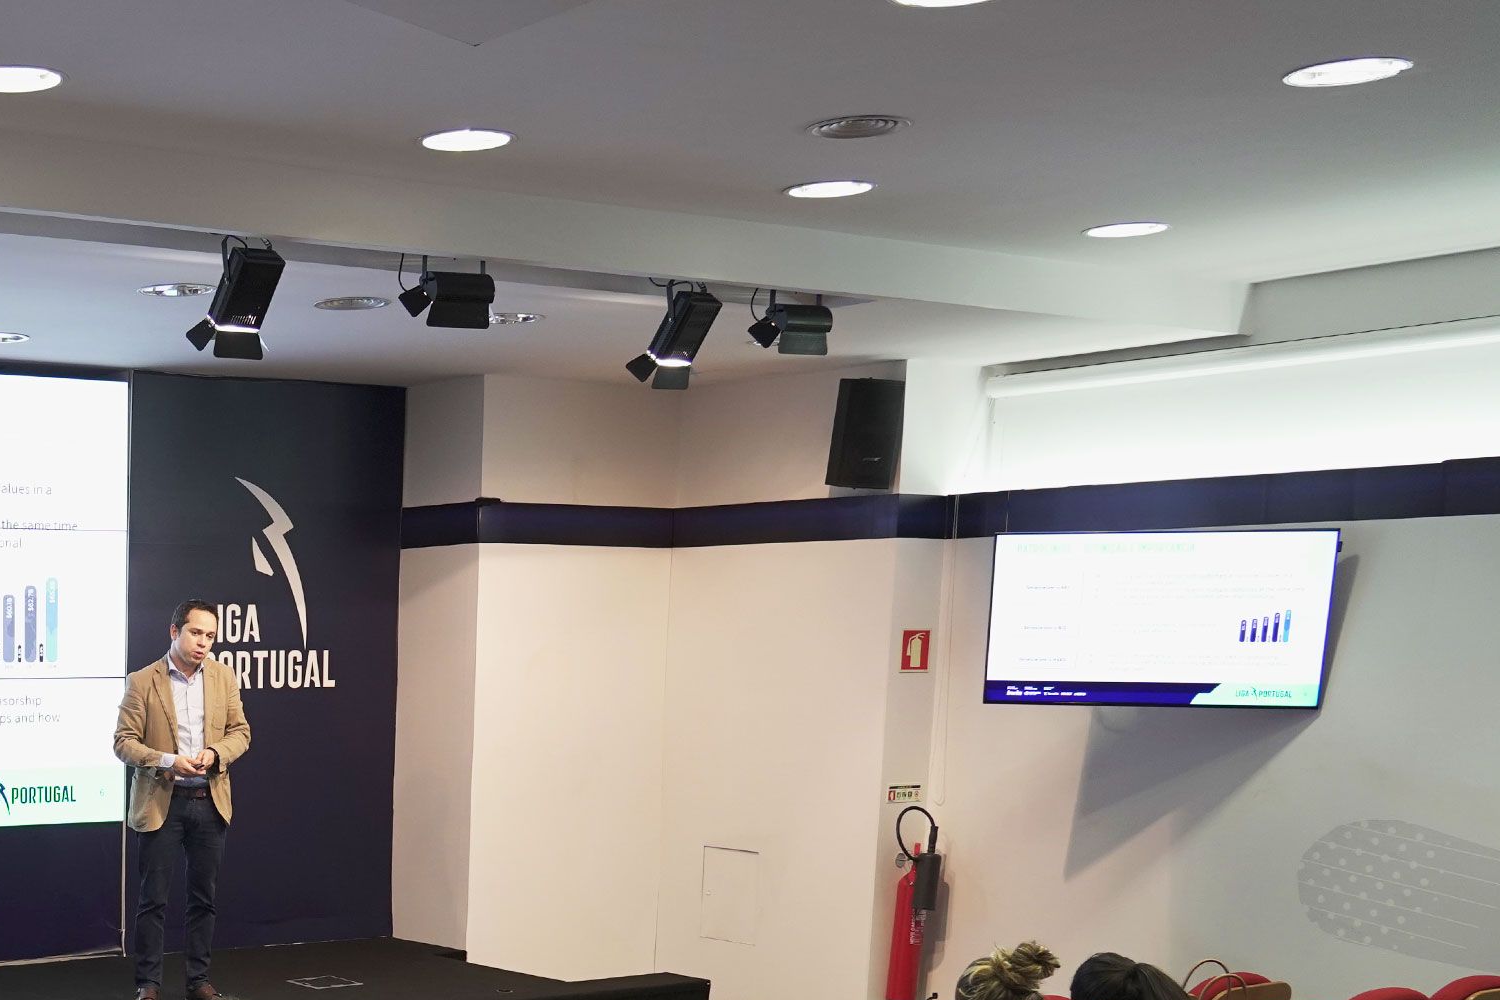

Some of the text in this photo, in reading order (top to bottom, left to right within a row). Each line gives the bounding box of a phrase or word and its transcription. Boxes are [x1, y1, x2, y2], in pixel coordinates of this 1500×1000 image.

[45, 486, 52, 496] a
[1, 519, 20, 530] the
[22, 521, 51, 531] same
[52, 521, 79, 532] time
[216, 603, 261, 644] IGA
[207, 649, 336, 689] RTUGAL
[15, 713, 35, 724] and
[38, 712, 60, 724] how
[11, 785, 77, 805] PORTUGAL
